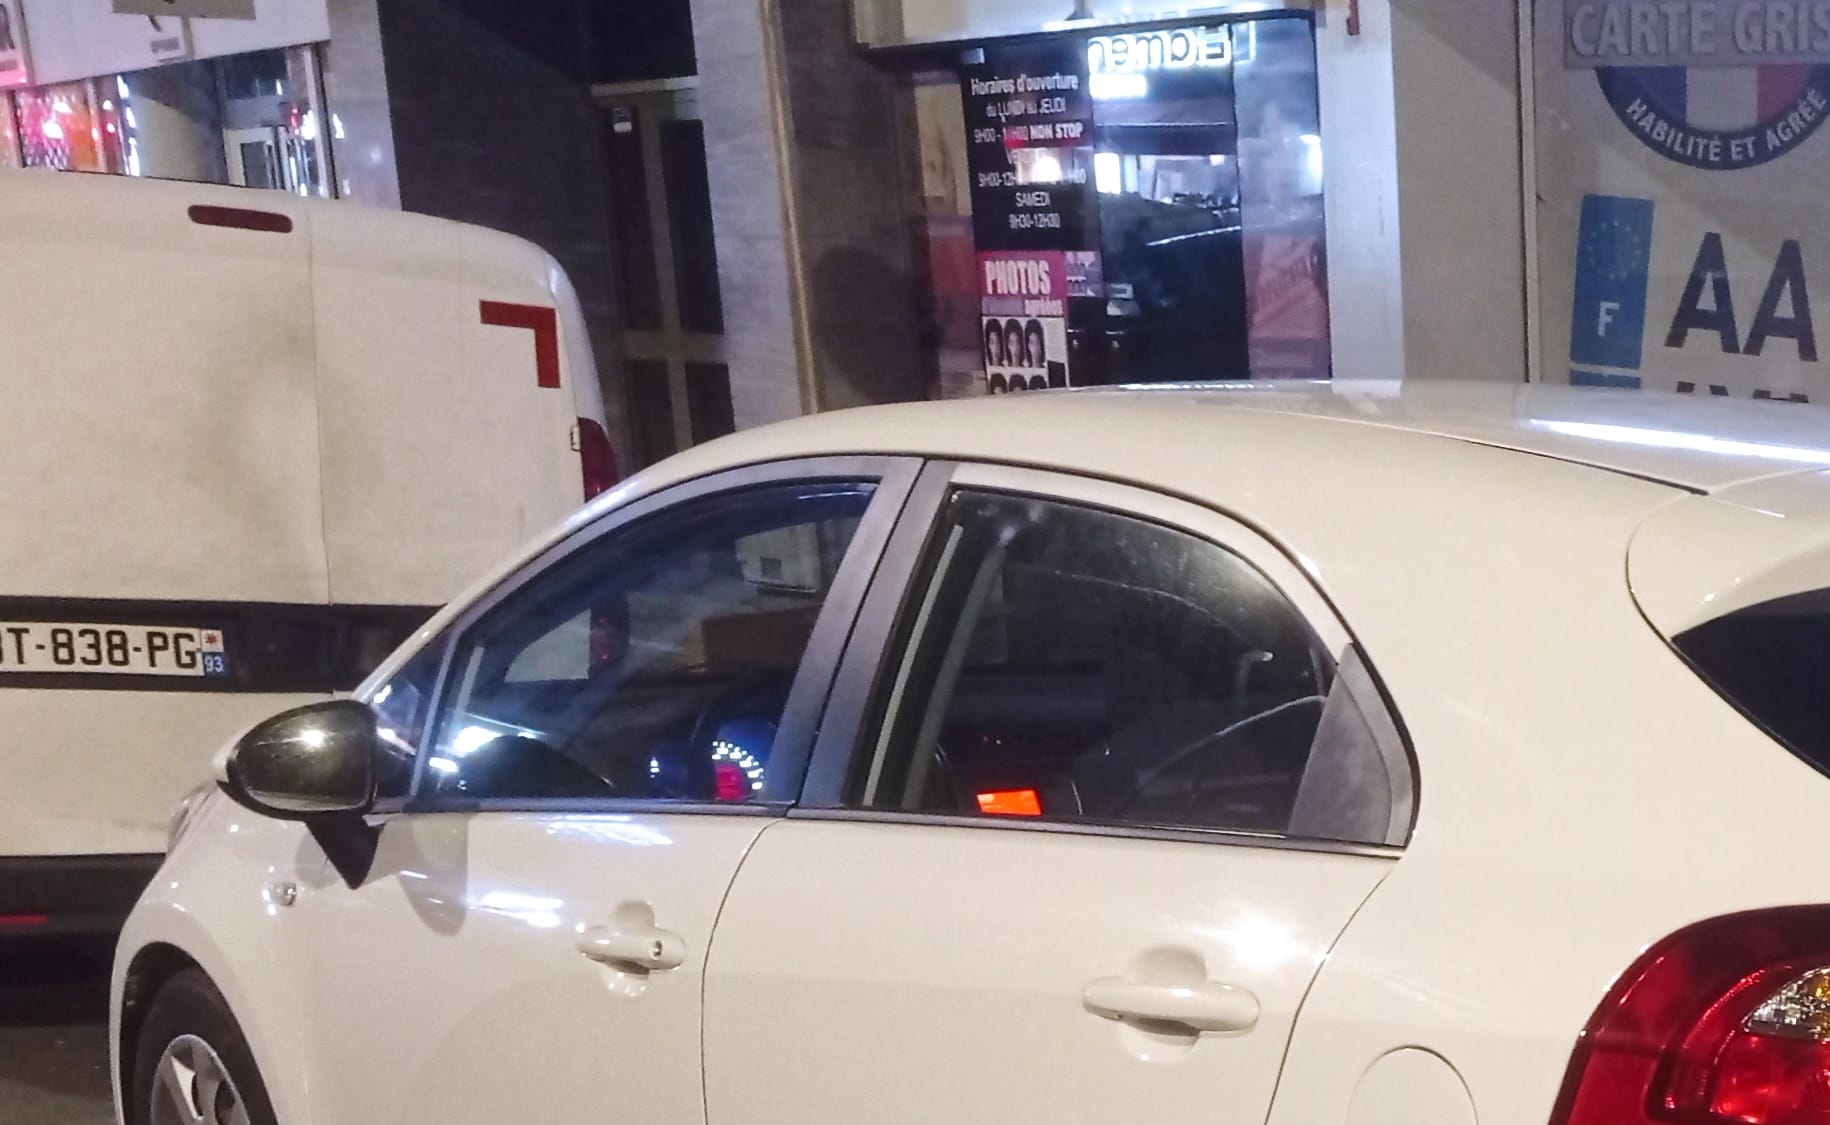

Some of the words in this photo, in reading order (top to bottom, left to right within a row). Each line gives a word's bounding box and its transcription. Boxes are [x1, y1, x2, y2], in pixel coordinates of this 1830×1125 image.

[1571, 1, 1717, 56] CARTE
[970, 76, 1015, 95] Horaires
[1016, 72, 1079, 92] d'ouverture
[1040, 97, 1066, 113] JEUDI
[1030, 123, 1054, 141] NON
[1055, 122, 1083, 139] STOP
[1730, 136, 1756, 161] ET
[1016, 192, 1051, 207] SAMEDI
[985, 260, 1051, 295] PHOTOS
[1597, 302, 1617, 338] F
[0, 627, 198, 669] T-838-PG
[204, 656, 224, 673] 93
